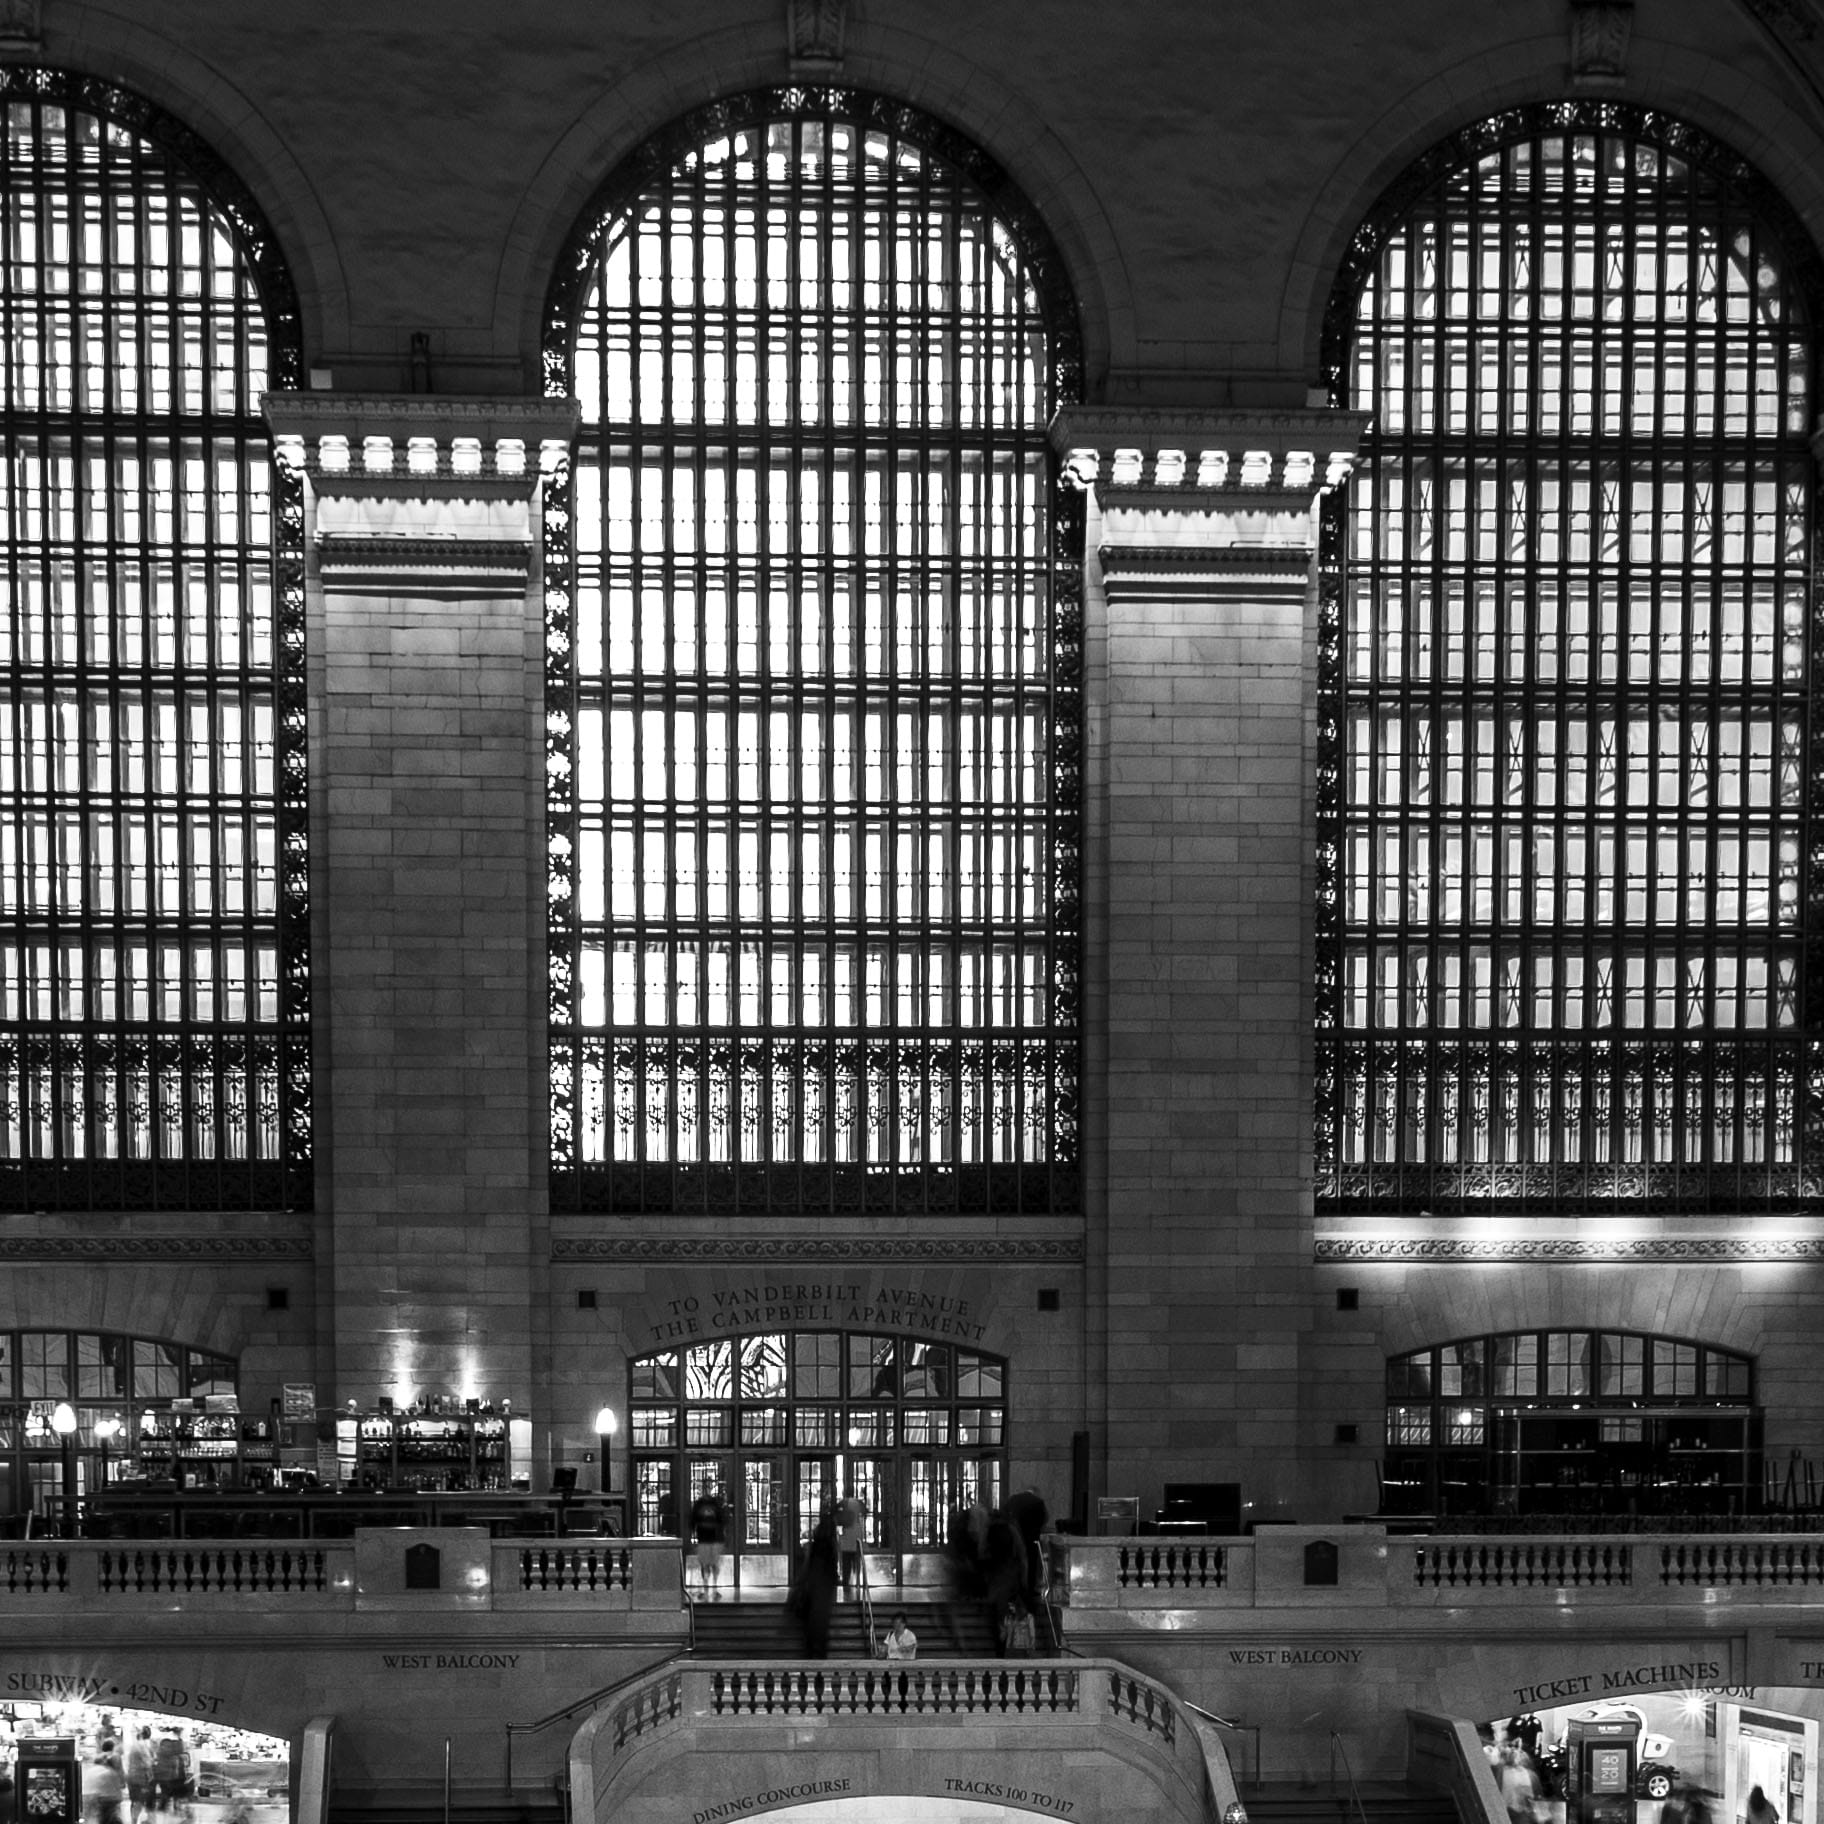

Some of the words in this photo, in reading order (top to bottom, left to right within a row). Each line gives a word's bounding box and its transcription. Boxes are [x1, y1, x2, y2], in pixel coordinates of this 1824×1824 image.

[668, 1296, 699, 1316] TO
[711, 1284, 861, 1308] VANDERBILT
[876, 1287, 968, 1316] AVENUE
[650, 1318, 699, 1341] THE
[711, 1305, 833, 1328] CAMPBELL
[847, 1305, 986, 1341] APARTMENT
[382, 1654, 432, 1669] WEST
[435, 1654, 521, 1669] BALCONY
[1229, 1650, 1276, 1664] WEST
[1280, 1650, 1363, 1664] BALCONY
[7, 1672, 109, 1697] SUBWAY
[126, 1683, 190, 1709] 42ND
[194, 1694, 226, 1716] ST
[1513, 1675, 1593, 1706] TICKET
[1601, 1661, 1720, 1691] MACHINES
[756, 1778, 852, 1805] CONCOURSE
[944, 1778, 1003, 1797] TRACKS
[1006, 1786, 1028, 1802] 100
[1031, 1791, 1053, 1808] TO
[1054, 1798, 1075, 1814] 117
